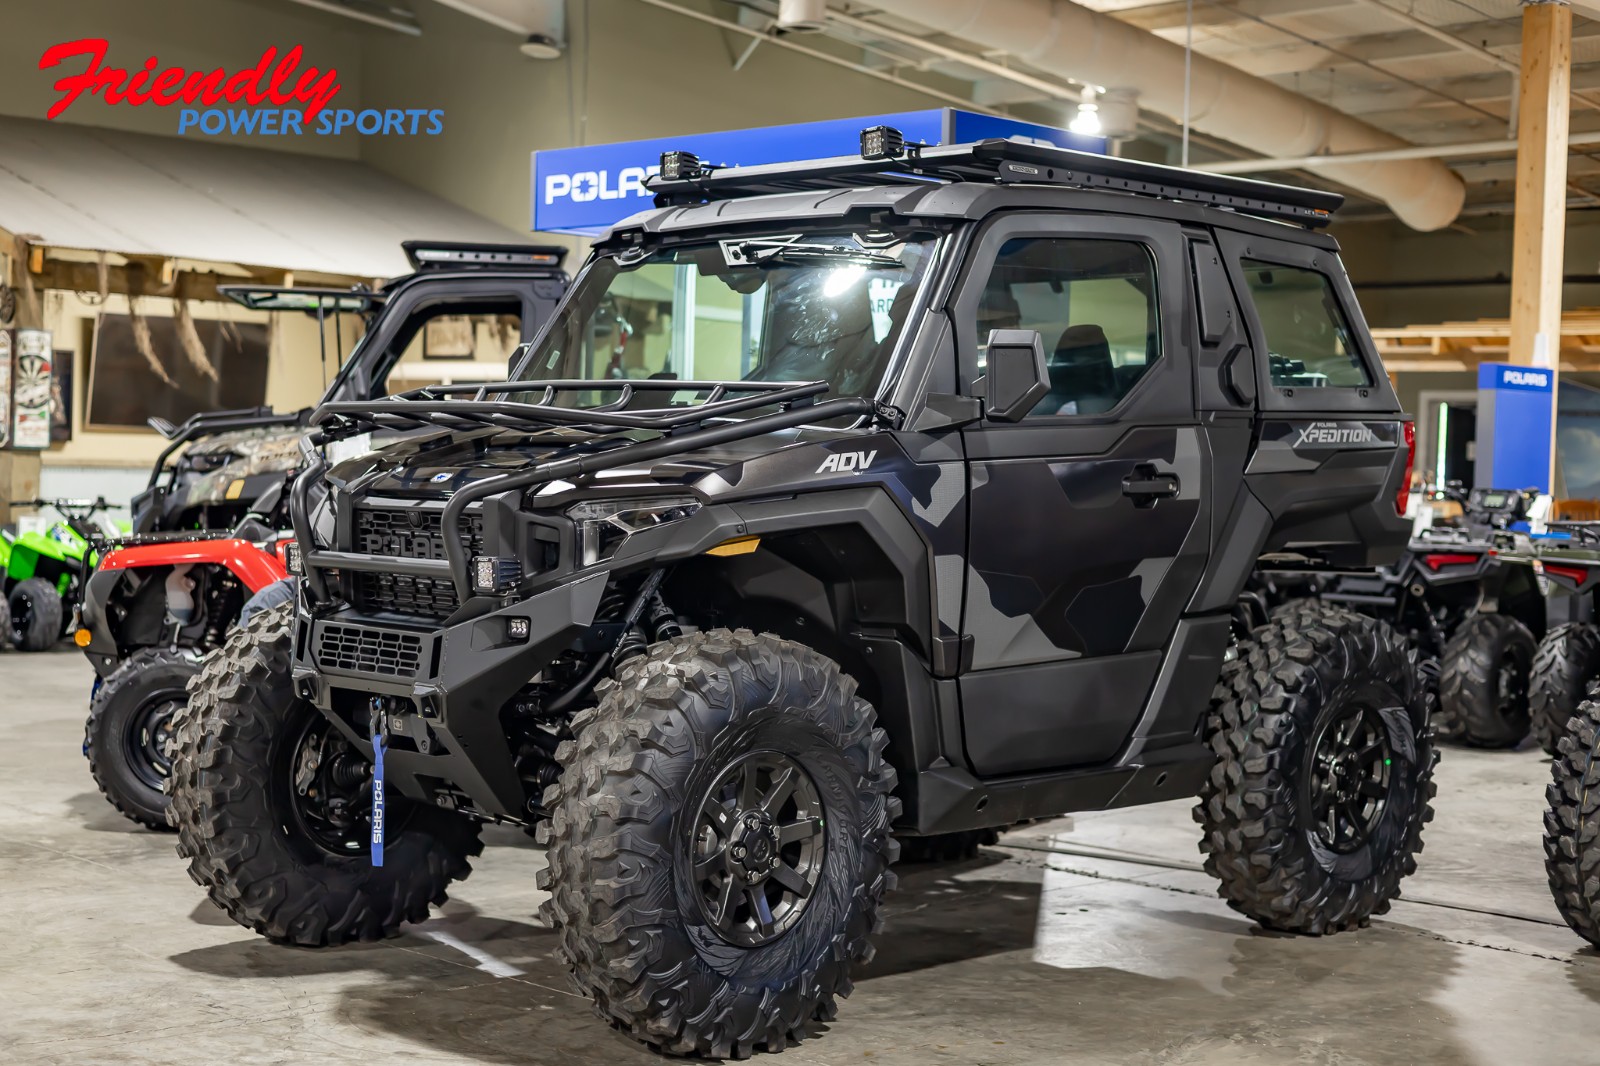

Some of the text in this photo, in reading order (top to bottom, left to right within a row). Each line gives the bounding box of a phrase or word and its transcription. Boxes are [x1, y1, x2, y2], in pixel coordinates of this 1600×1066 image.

[545, 161, 709, 205] POLA
[1503, 370, 1548, 387] POLARIS
[1293, 422, 1372, 448] XPEDITION
[814, 450, 878, 474] ADV
[373, 779, 383, 844] POLARIS
